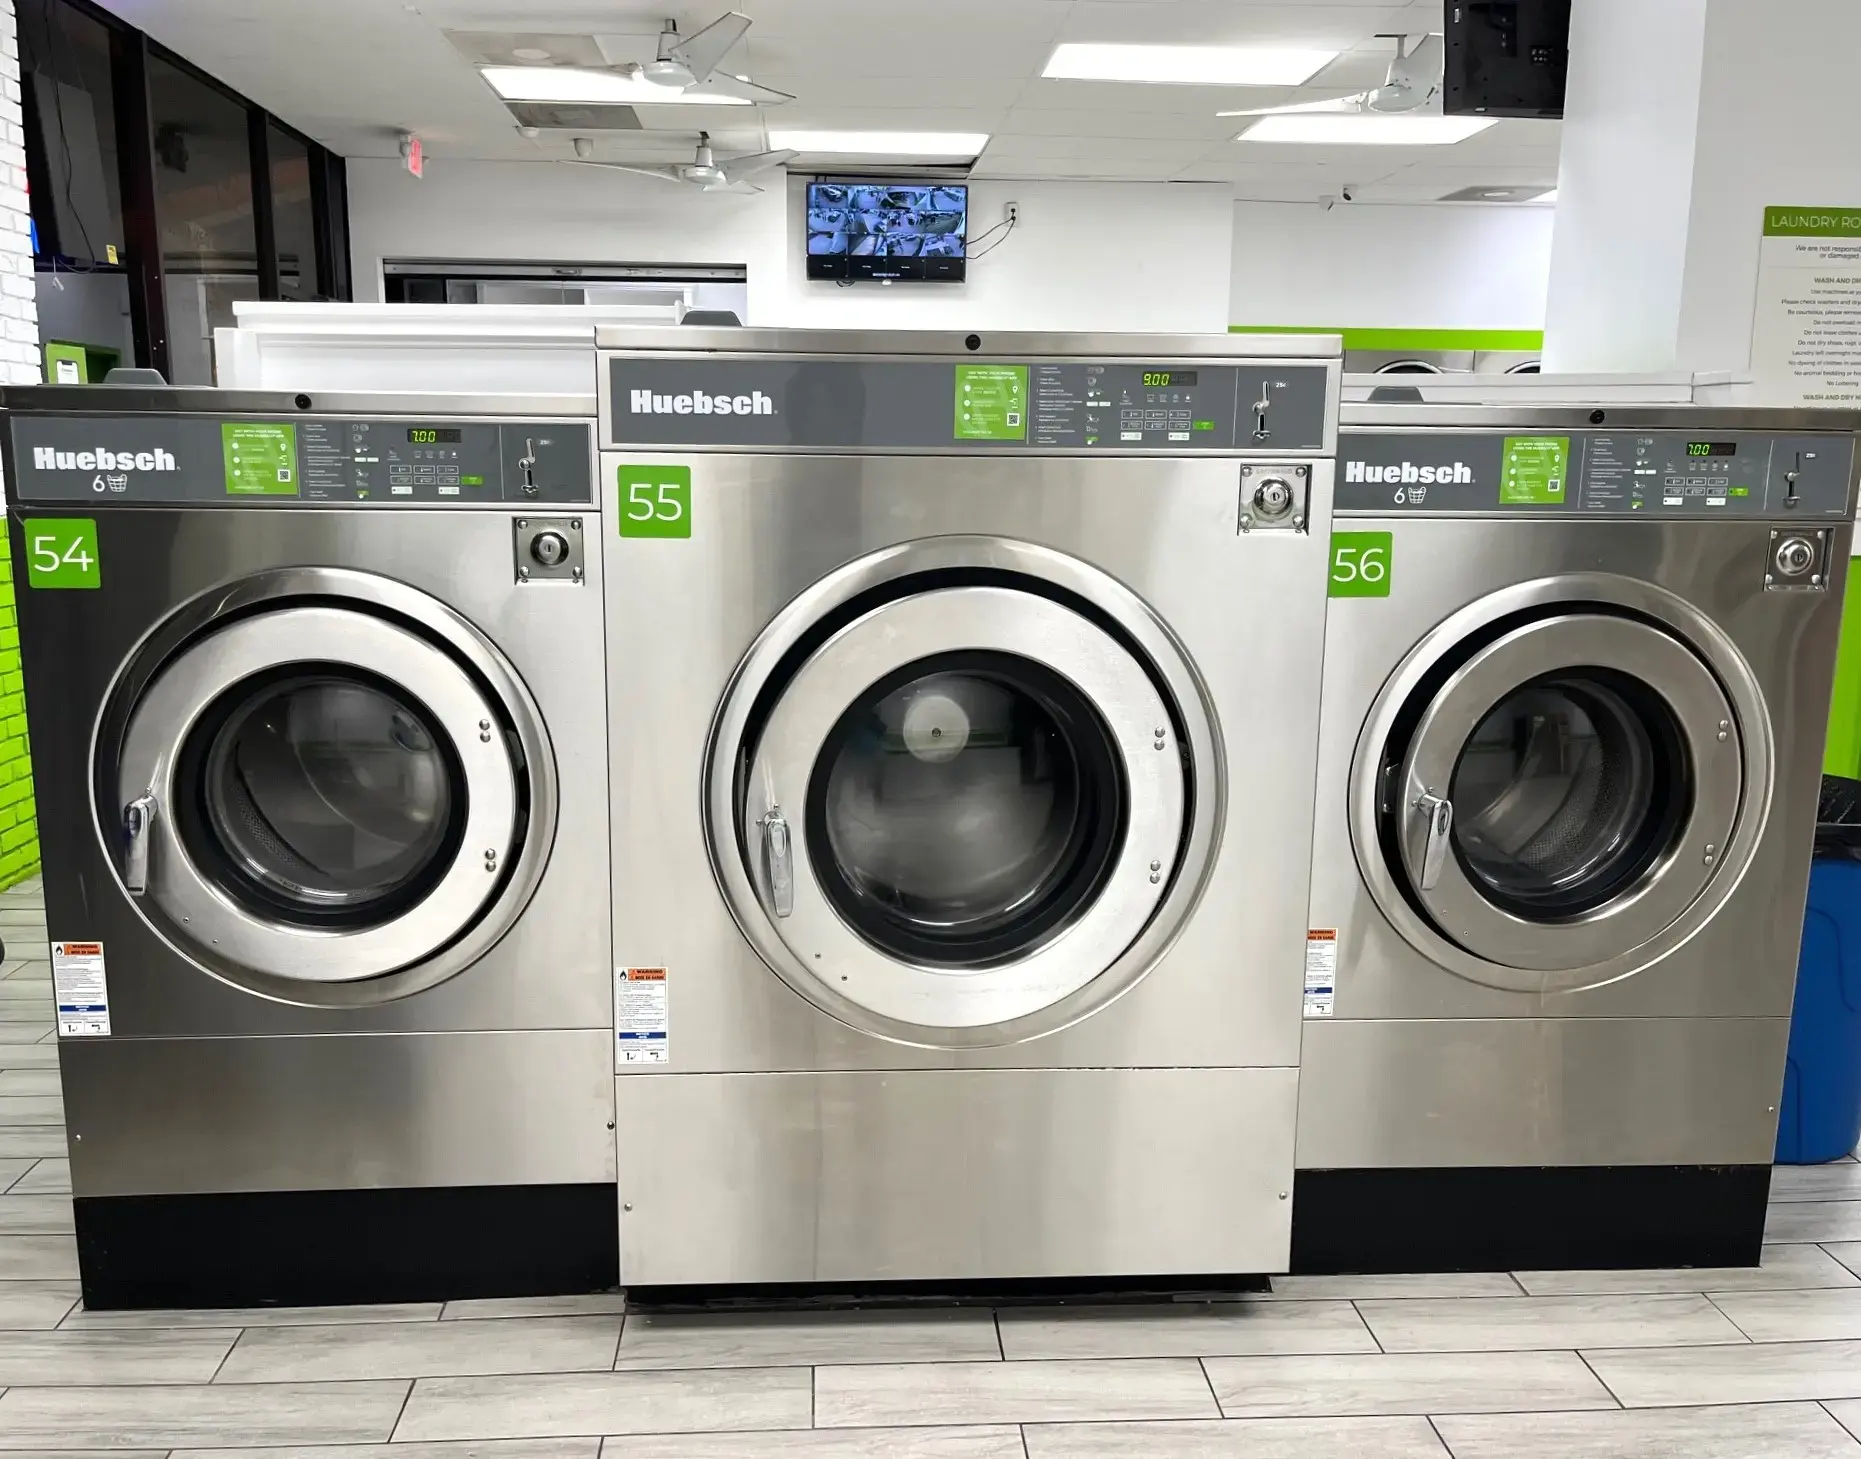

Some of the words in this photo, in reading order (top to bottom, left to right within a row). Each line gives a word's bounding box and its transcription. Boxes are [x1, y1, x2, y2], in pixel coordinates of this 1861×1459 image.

[1772, 216, 1838, 229] LAUNDRY
[1842, 216, 1861, 229] RO
[1144, 374, 1170, 386] 9.00
[630, 390, 774, 415] Huebsch
[412, 430, 436, 443] 7.00
[34, 447, 177, 471] Huebsch
[1688, 444, 1710, 456] 7.00
[92, 474, 105, 492] 6
[1345, 462, 1472, 484] Huebsch
[628, 484, 683, 521] 55
[1394, 487, 1405, 504] 6
[33, 536, 94, 574] 54
[1333, 548, 1385, 583] 56
